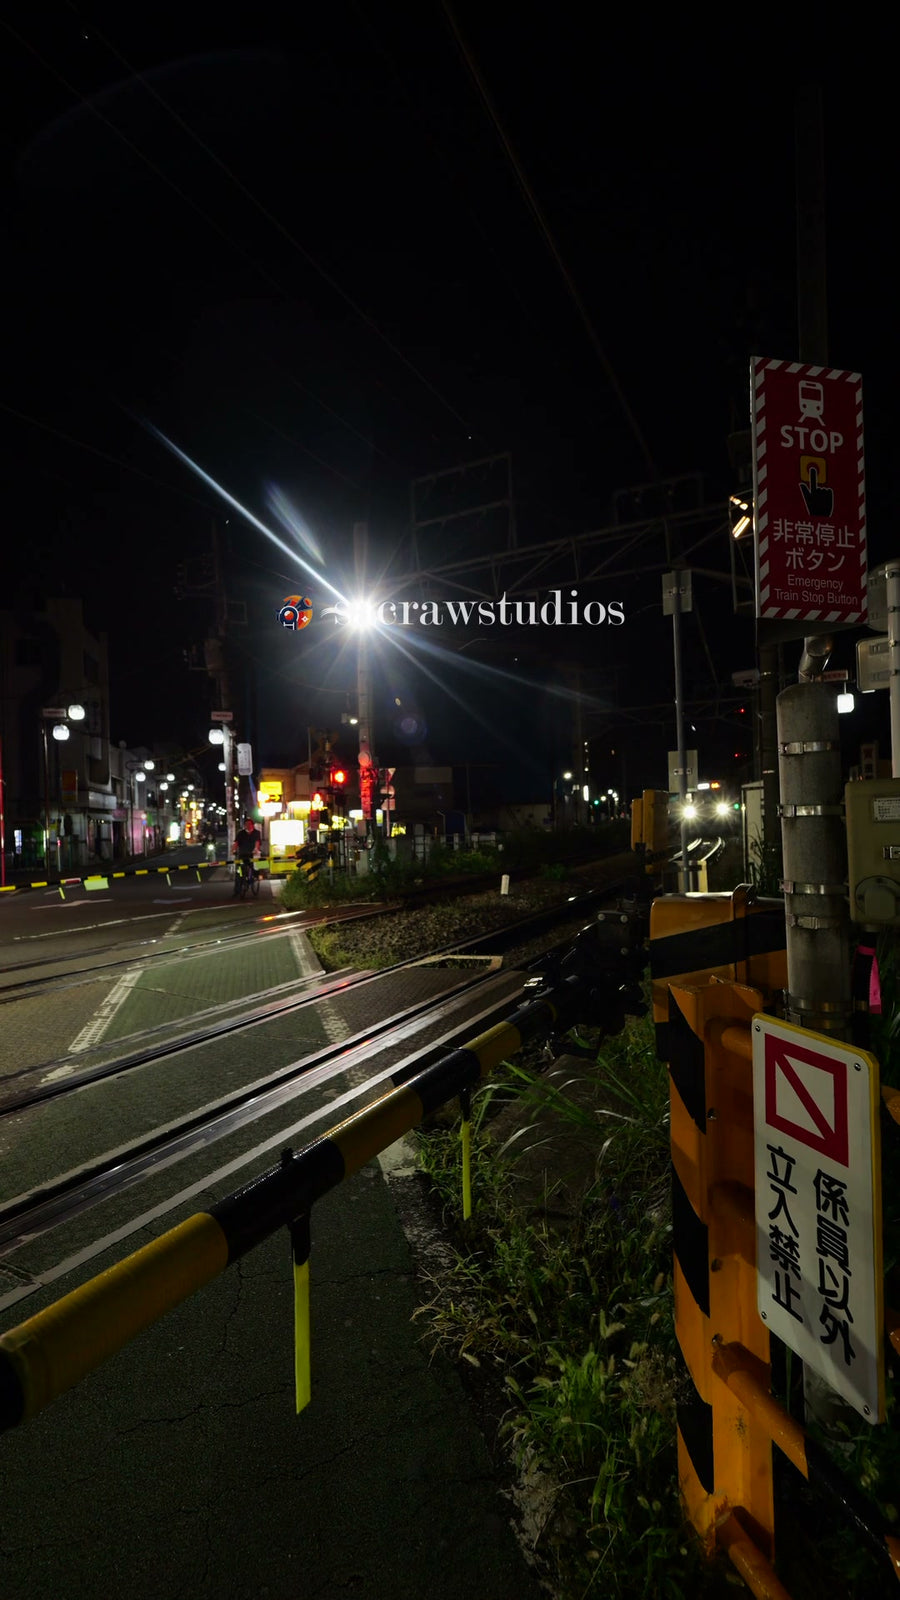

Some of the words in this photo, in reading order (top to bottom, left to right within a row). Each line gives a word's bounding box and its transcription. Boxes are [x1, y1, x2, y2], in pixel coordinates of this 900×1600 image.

[779, 424, 844, 454] STOP
[772, 518, 857, 549] 非常停止
[785, 548, 845, 572] ボタン
[774, 587, 799, 601] Train
[801, 589, 825, 606] Stop
[826, 590, 858, 606] Button
[787, 573, 844, 591] Emergency
[765, 1143, 804, 1324] 立入禁止
[812, 1168, 856, 1366] 係員以外
